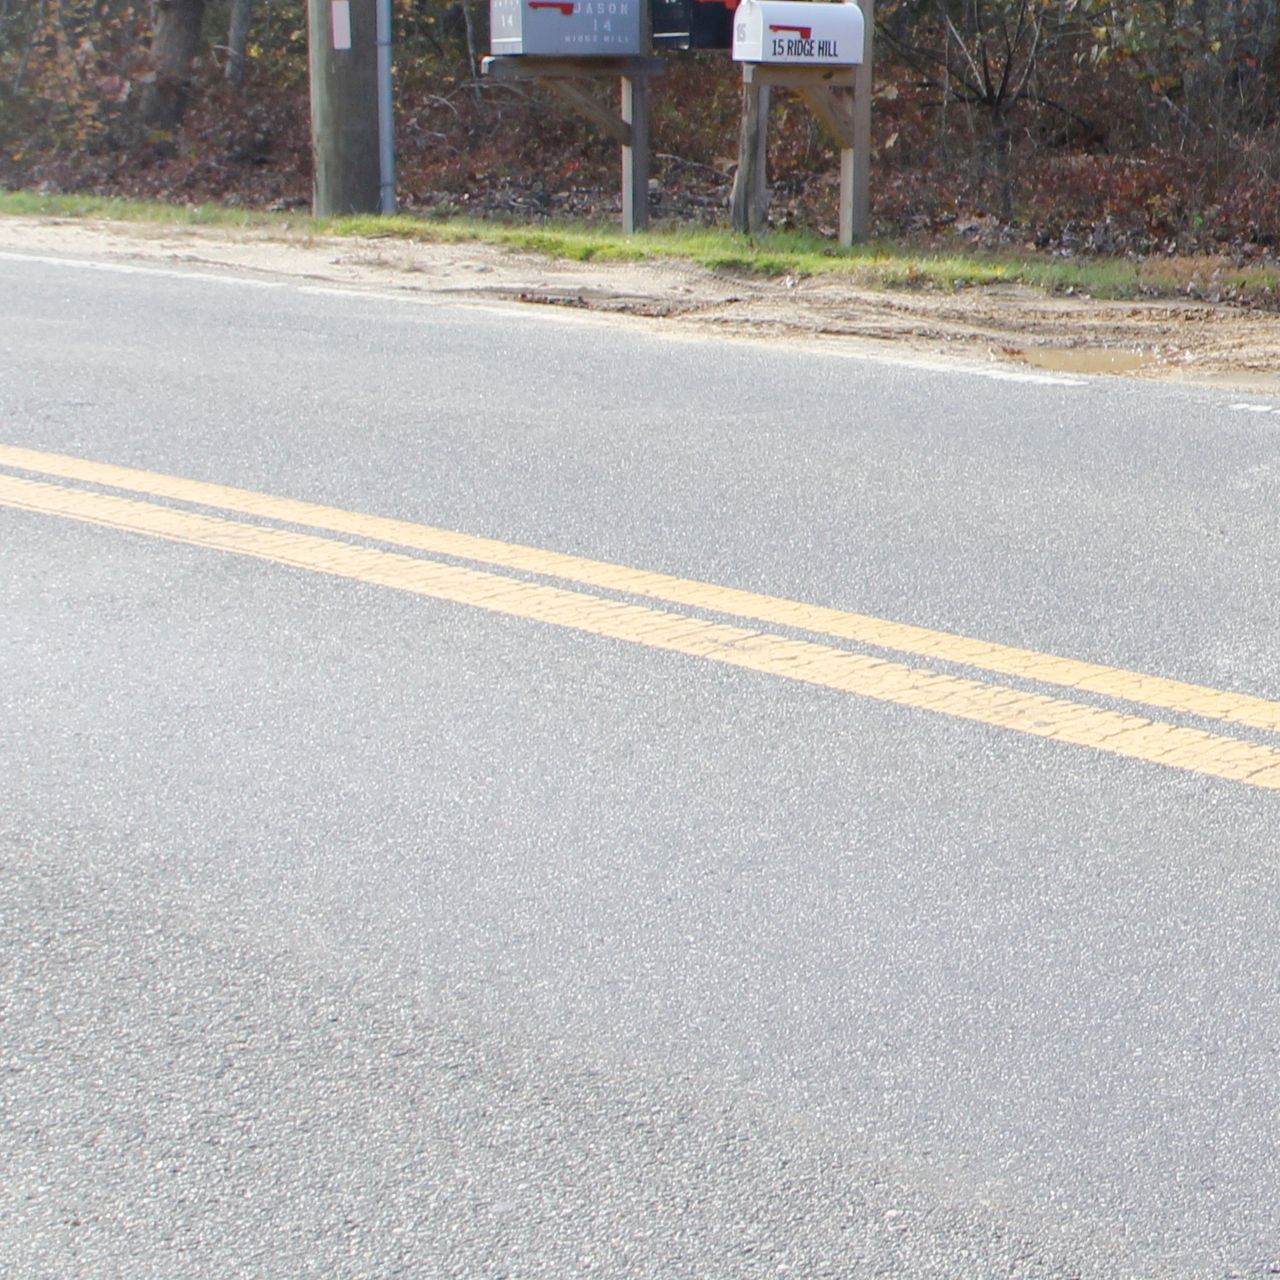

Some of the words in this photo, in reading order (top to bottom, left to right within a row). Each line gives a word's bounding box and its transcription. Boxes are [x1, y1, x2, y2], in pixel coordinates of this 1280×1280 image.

[574, 2, 628, 15] JASON
[502, 14, 513, 27] 14
[593, 19, 611, 32] 14
[604, 35, 629, 43] HILL
[772, 39, 784, 56] 15
[787, 39, 815, 56] RIDGE
[817, 40, 839, 57] HILL
